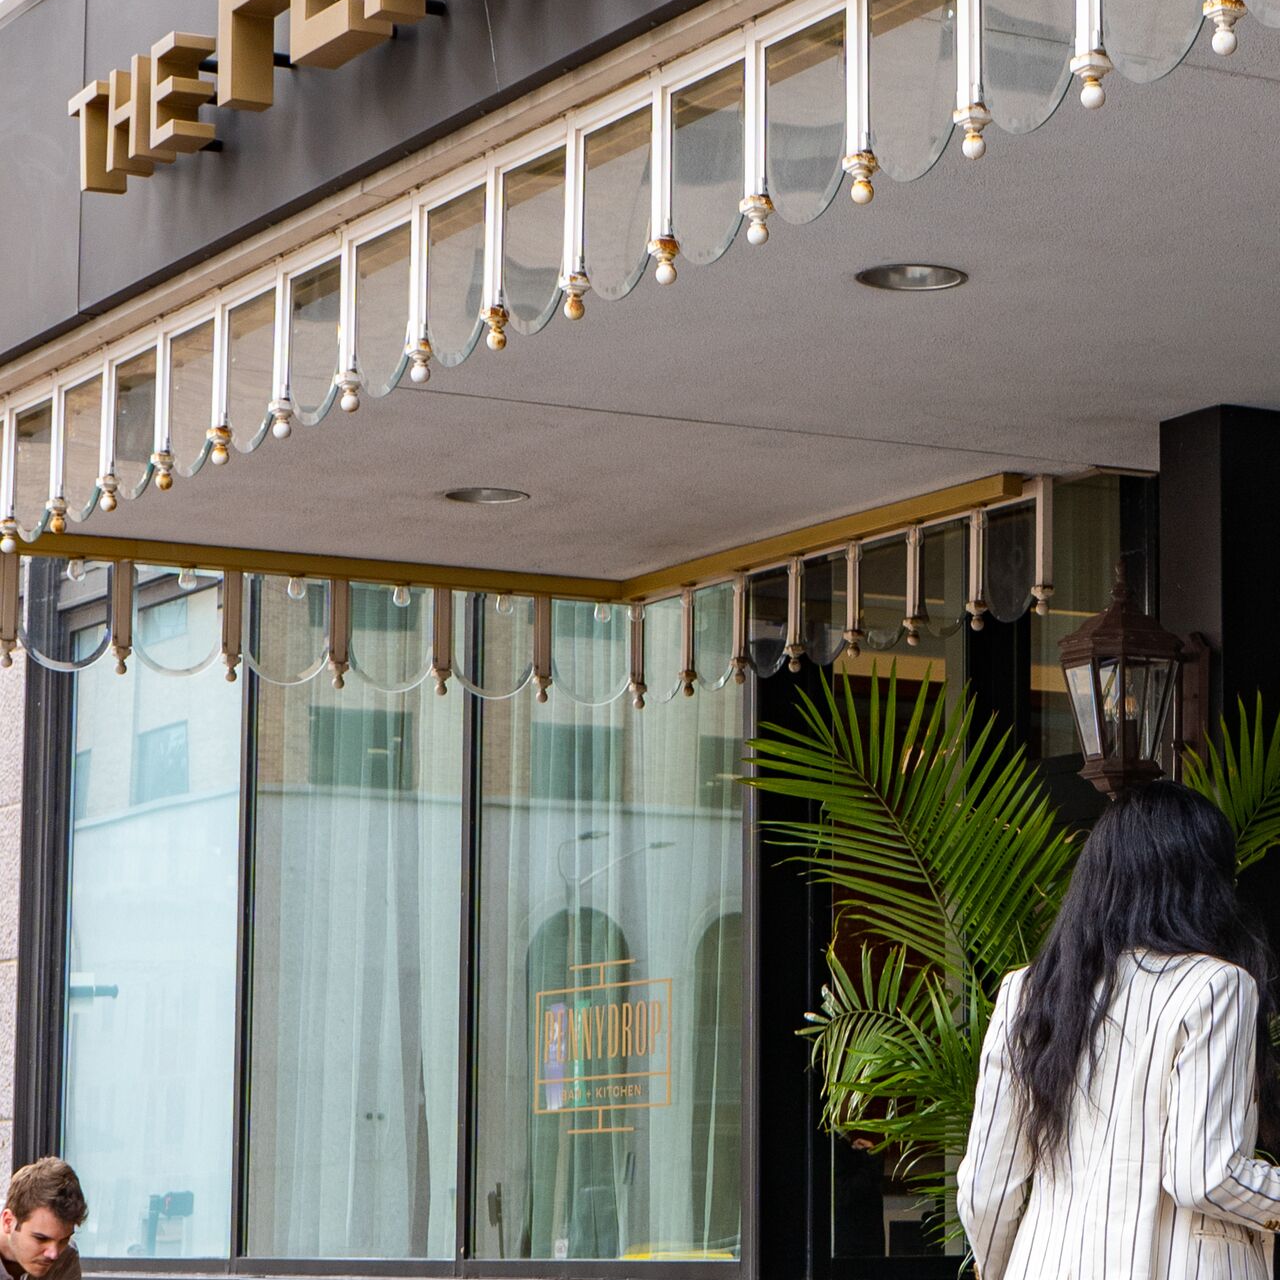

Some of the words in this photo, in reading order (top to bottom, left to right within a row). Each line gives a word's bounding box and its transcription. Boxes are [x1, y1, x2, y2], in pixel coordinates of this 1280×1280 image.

[68, 32, 216, 194] THE
[544, 1000, 661, 1063] PENNYDROP
[561, 1088, 582, 1102] BAR
[595, 1085, 641, 1098] KITCHEN
